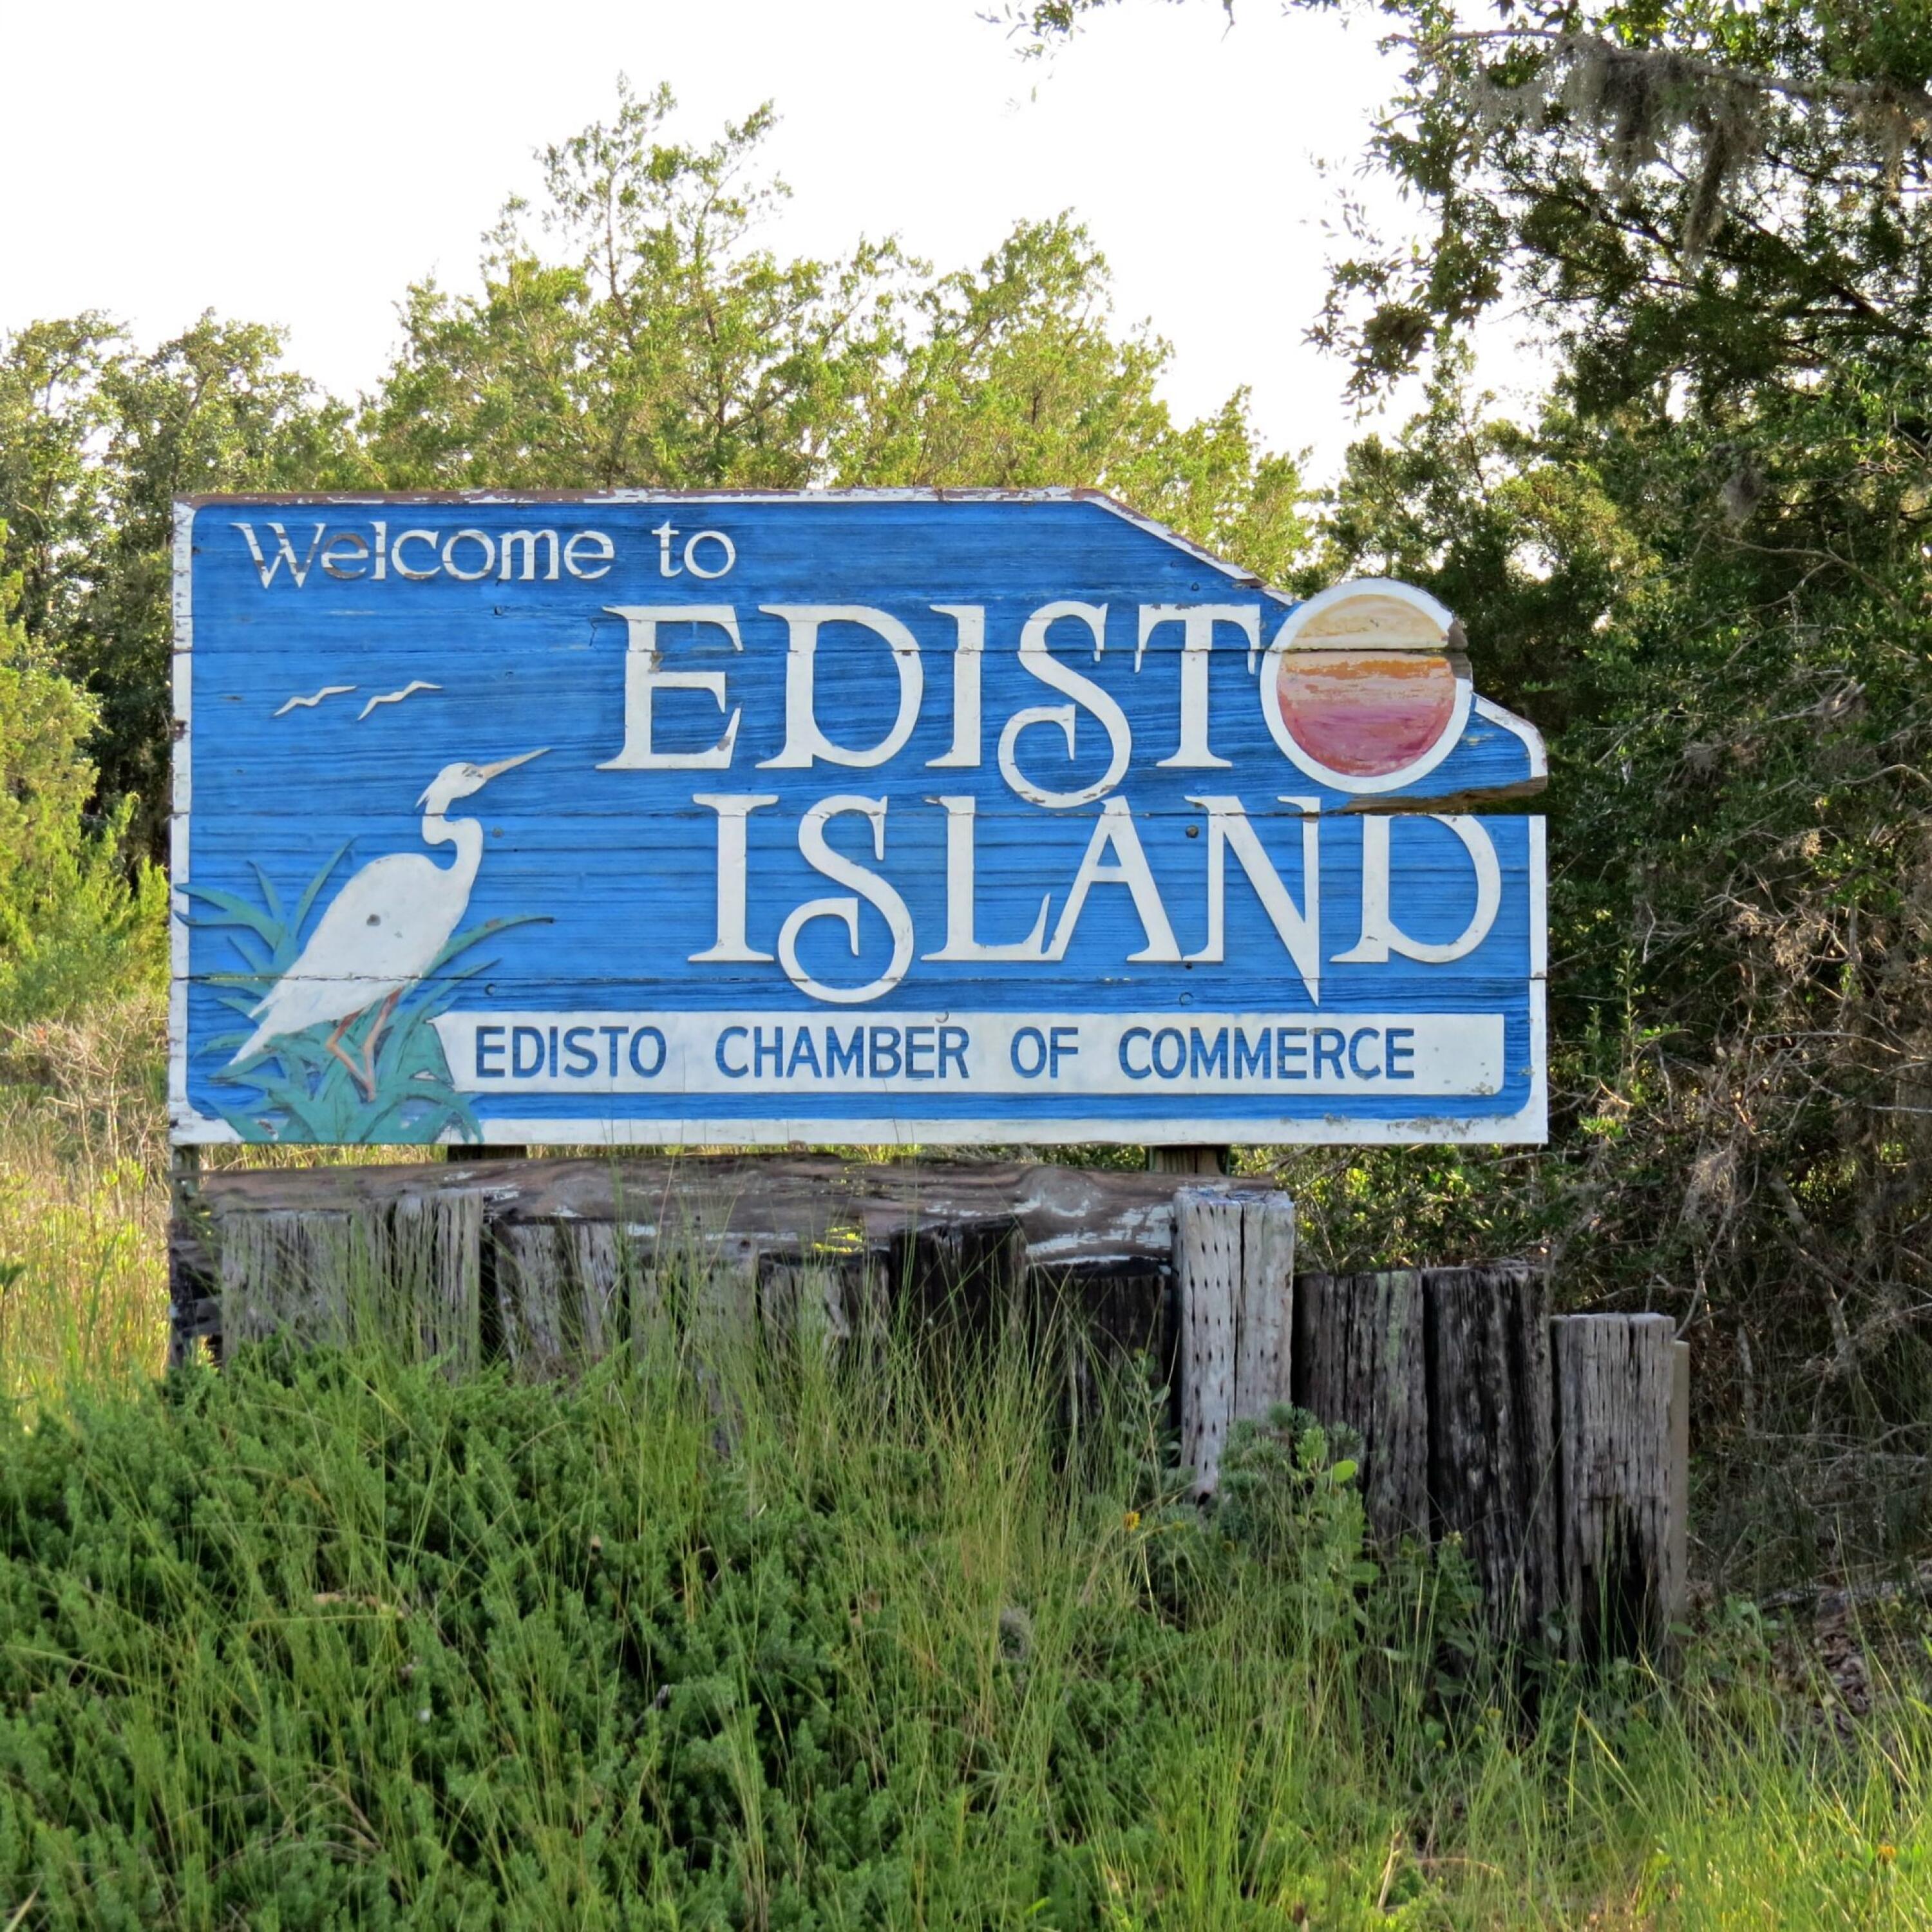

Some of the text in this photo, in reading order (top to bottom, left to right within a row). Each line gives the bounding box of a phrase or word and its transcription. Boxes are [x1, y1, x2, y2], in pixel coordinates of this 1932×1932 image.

[229, 520, 736, 589] Welcome to
[595, 576, 1474, 810] EDISTO
[687, 793, 1502, 1007] ISLAND
[475, 1025, 1416, 1081] EDISTO CHAMBER OF COMMERCE
